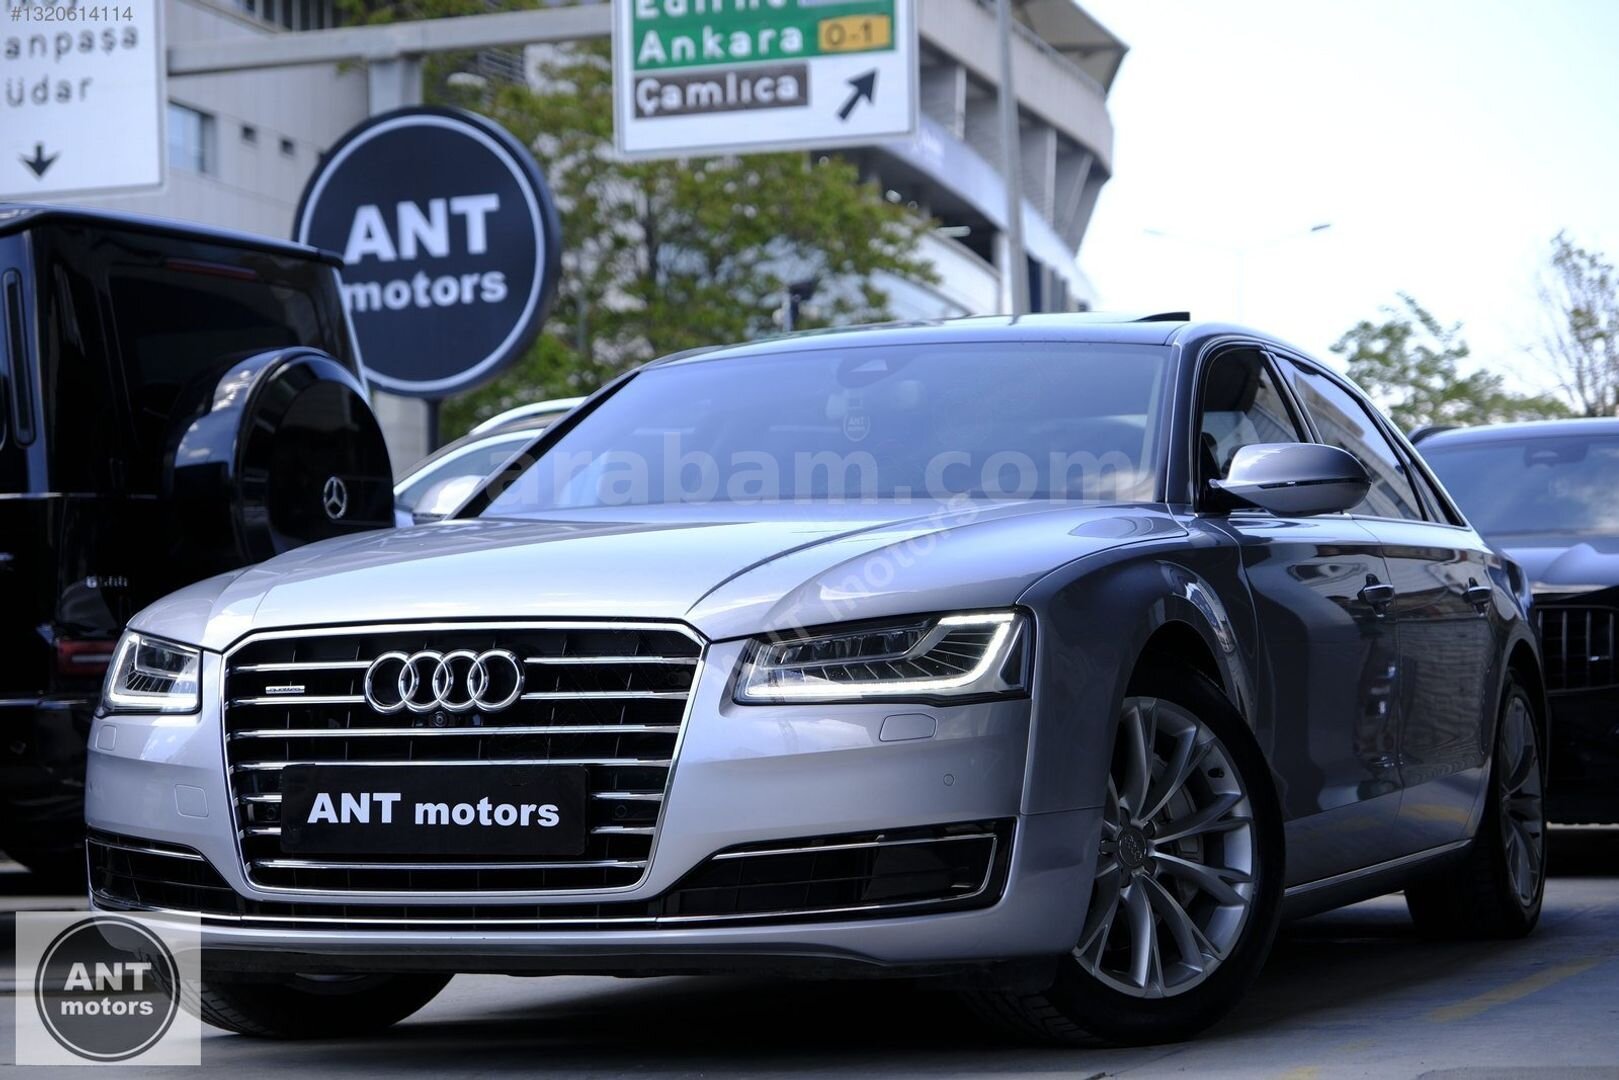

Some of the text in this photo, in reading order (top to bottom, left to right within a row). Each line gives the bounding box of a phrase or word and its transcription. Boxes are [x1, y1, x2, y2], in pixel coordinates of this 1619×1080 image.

[637, 25, 804, 65] Ankara
[635, 71, 800, 115] Çamlıca
[343, 193, 499, 265] ANT
[342, 270, 508, 312] motors
[307, 792, 560, 827] ANT motors
